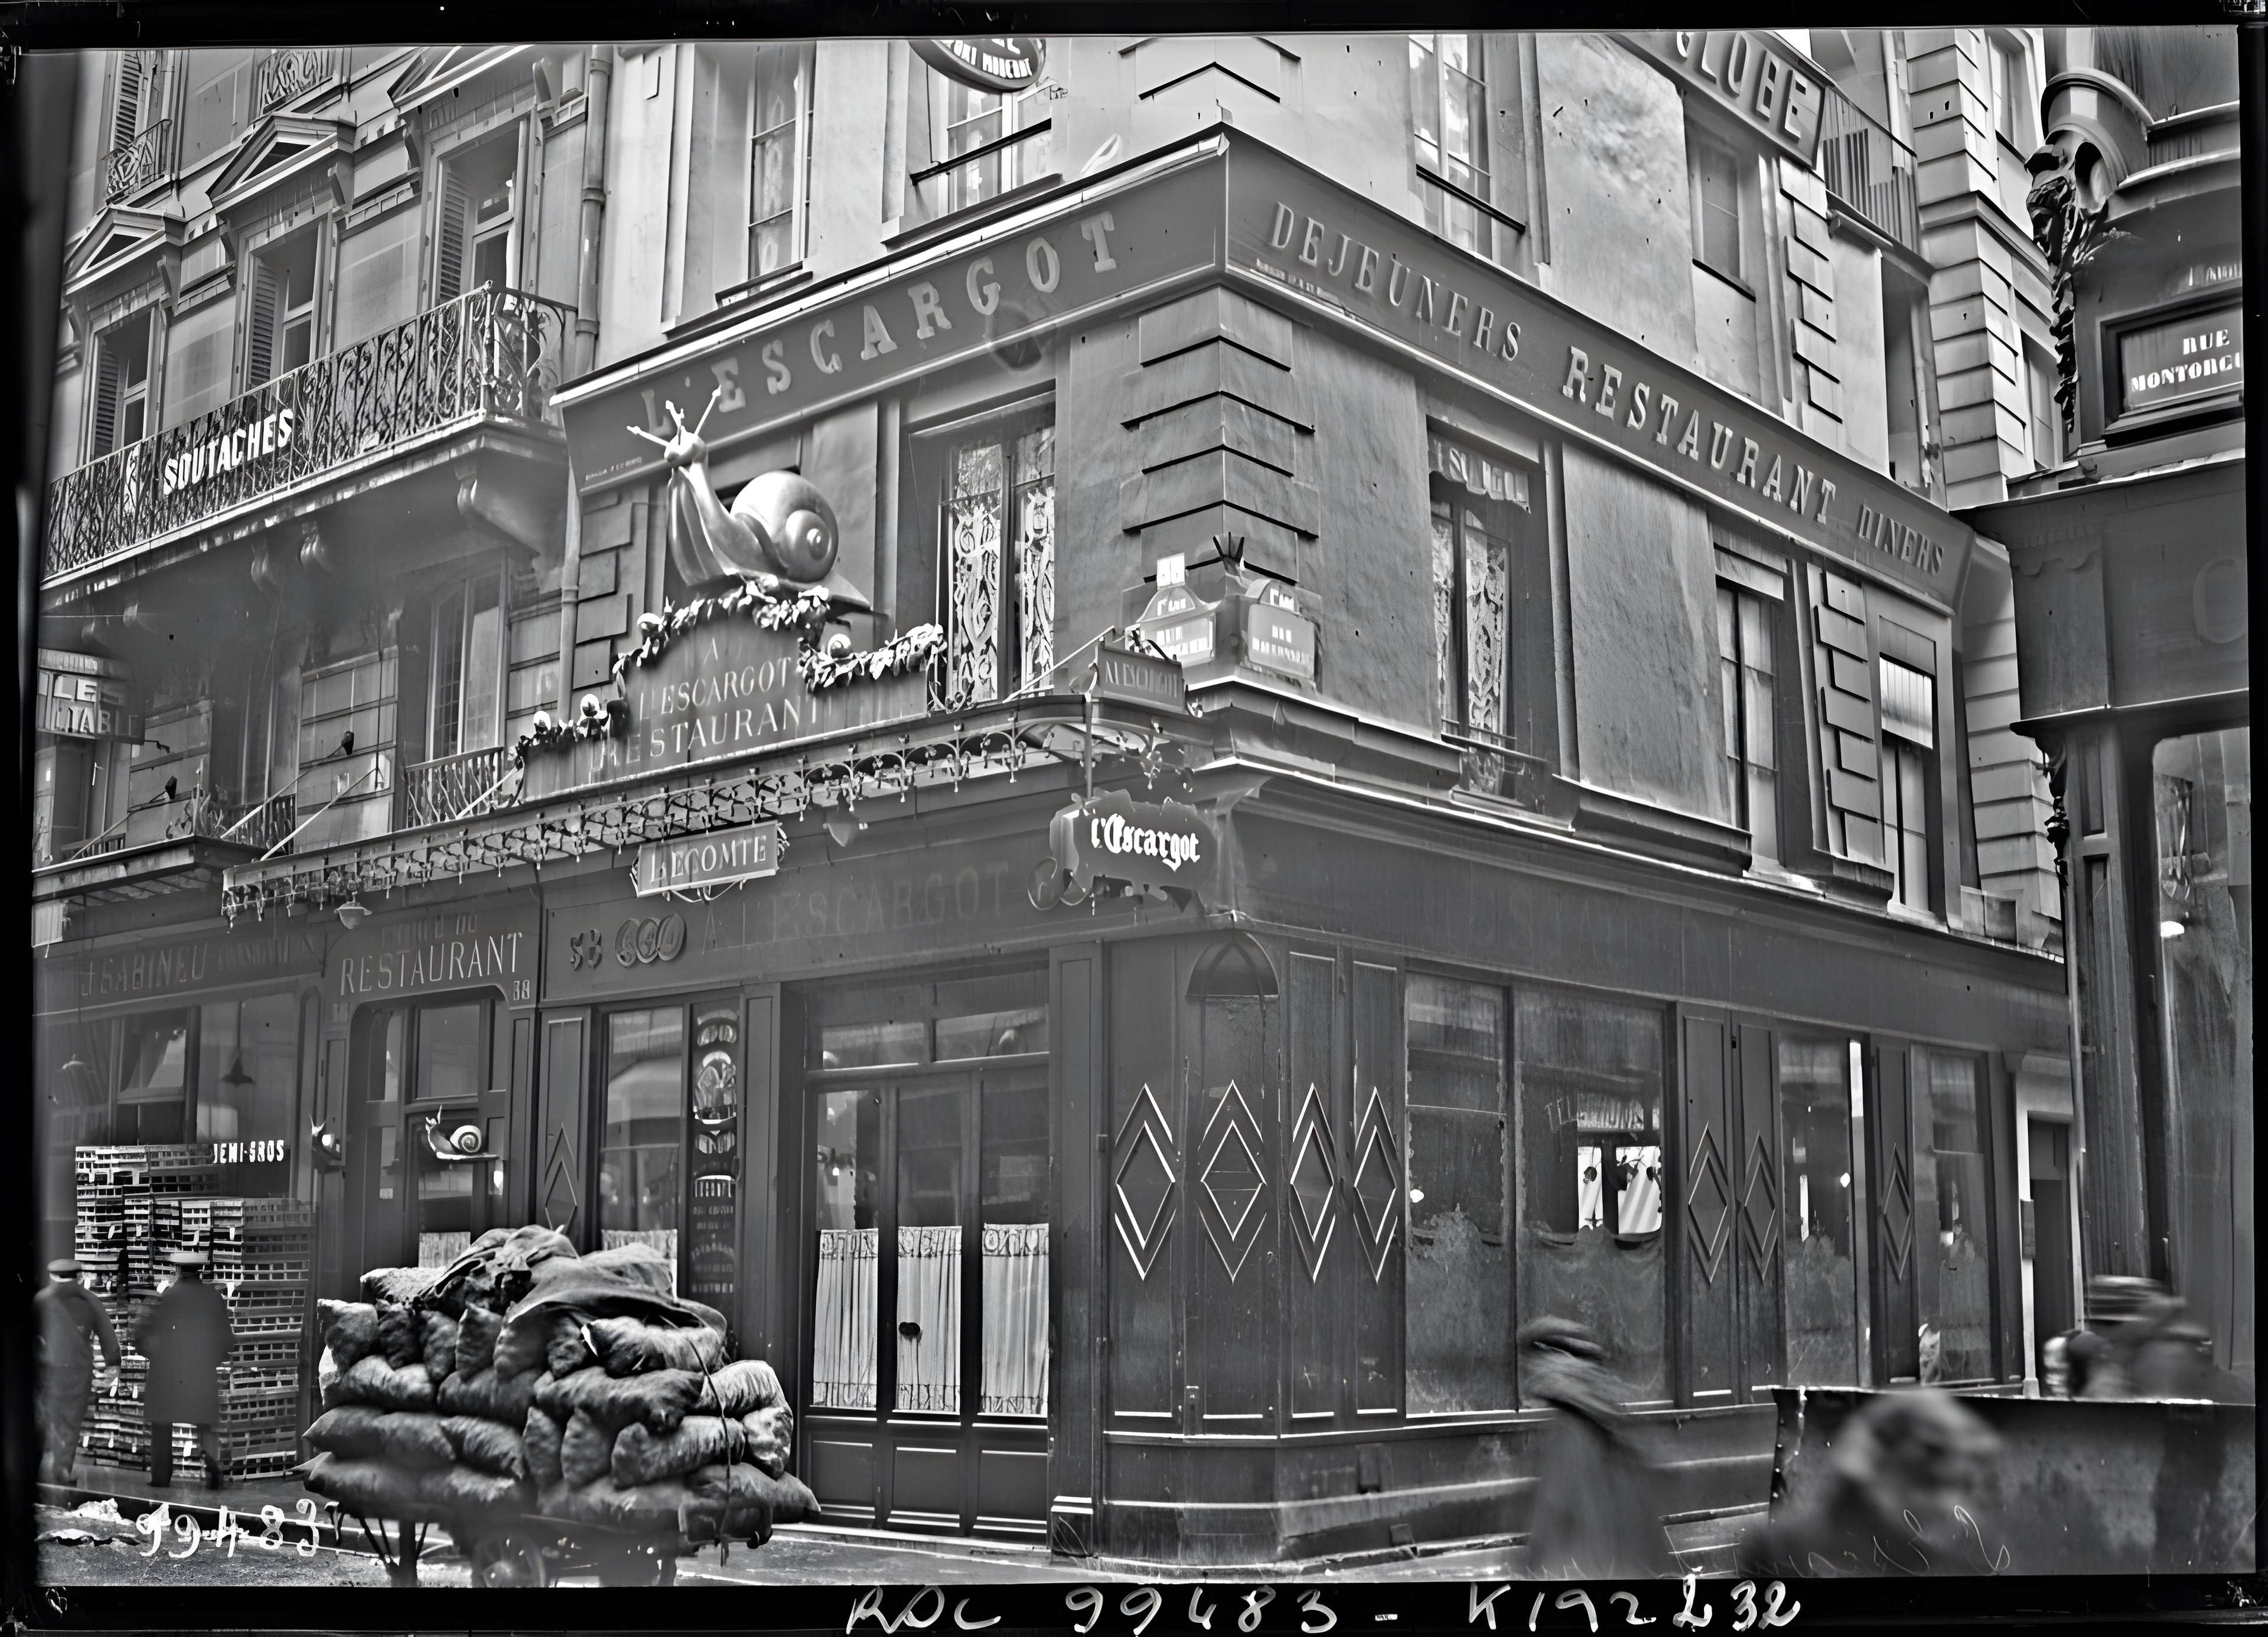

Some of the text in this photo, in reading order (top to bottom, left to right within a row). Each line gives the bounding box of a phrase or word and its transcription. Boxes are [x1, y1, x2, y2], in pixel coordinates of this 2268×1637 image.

[641, 210, 1118, 438] L'ESCARGOT
[2183, 329, 2230, 355] RUE
[1271, 201, 1944, 574] DEJEUNERS RESTAURANT DINERS
[163, 408, 294, 499] SOUTACHES
[703, 637, 719, 666] A
[651, 834, 767, 883] LECOMTE
[1091, 813, 1201, 872] l'Escargot
[340, 932, 523, 996] RESTAURANT
